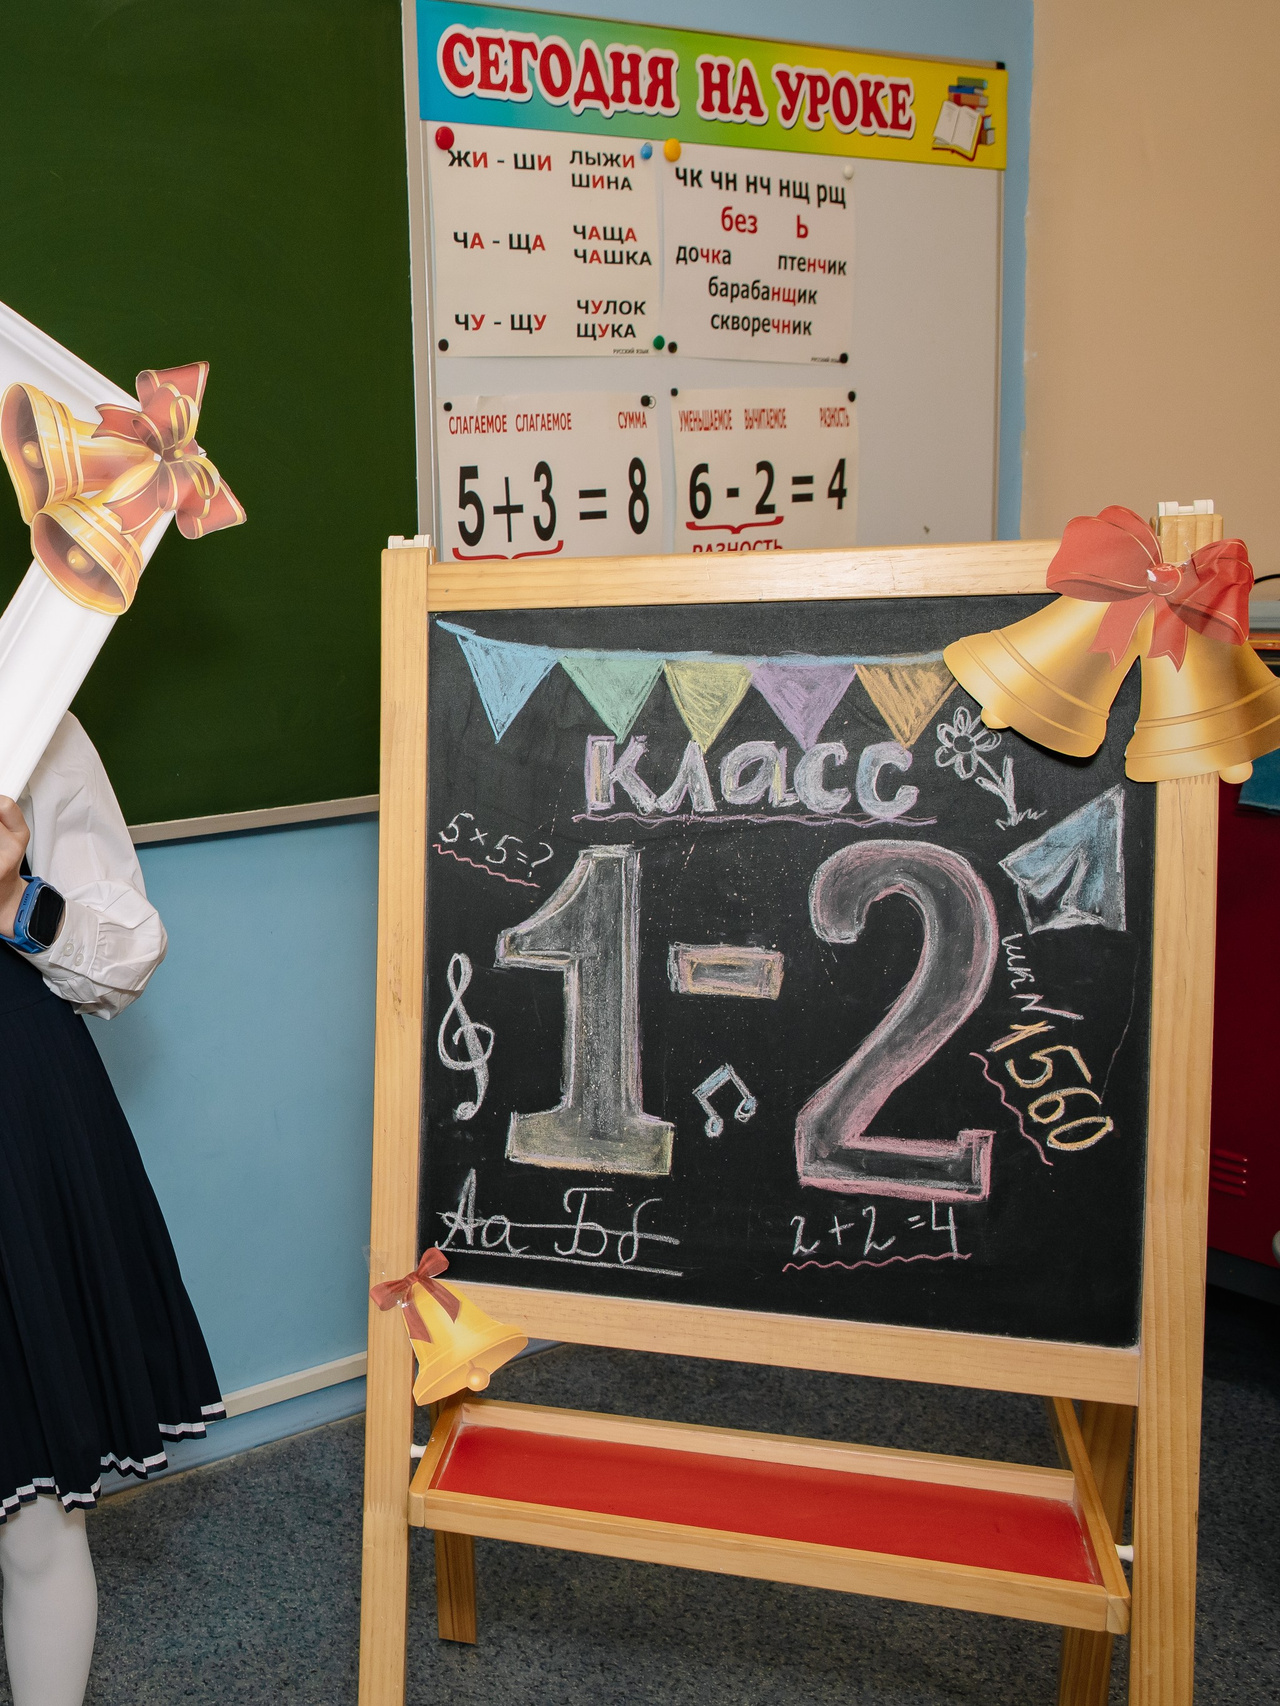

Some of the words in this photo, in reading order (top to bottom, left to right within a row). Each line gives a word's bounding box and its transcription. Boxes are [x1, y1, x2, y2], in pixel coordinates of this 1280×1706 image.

[441, 32, 677, 112] СЕГОДНЯ
[699, 55, 766, 118] НА
[775, 69, 914, 132] УРОКЕ
[448, 150, 489, 169] ЖИ
[513, 153, 552, 172] ШИ
[569, 150, 636, 169] ЛЫЖИ
[571, 173, 634, 191] ШИНА
[675, 167, 703, 189] чк
[710, 170, 738, 192] чн
[746, 174, 772, 196] нч
[779, 178, 811, 205] нщ
[816, 183, 847, 209] рщ
[721, 206, 758, 235] без
[453, 231, 485, 249] ЧА
[508, 233, 546, 254] ЩА
[573, 225, 638, 244] ЧАЩА
[573, 248, 653, 266] ЧАШКА
[675, 245, 732, 265] дочка
[778, 254, 847, 276] птенчик
[708, 276, 818, 307] барабанщик
[576, 299, 646, 316] ЧУЛОК
[454, 313, 486, 331] ЧУ
[510, 313, 547, 334] ЩУ
[576, 322, 637, 341] ЩУКА
[710, 313, 813, 337] скворечник
[449, 414, 507, 435] СЛАГАЕМОЕ
[515, 412, 572, 432] СЛАГАЕМОЕ
[618, 411, 648, 429] СУММА
[678, 409, 733, 432] УМЕНЬШАЕМОЕ
[744, 408, 787, 430] ВЫЧИТАЕМОЕ
[819, 406, 850, 428] РАЗНОСТЬ
[628, 456, 649, 535] 8
[827, 458, 847, 510] 4
[434, 1168, 530, 1254] Аа
[554, 1187, 663, 1265] Бб
